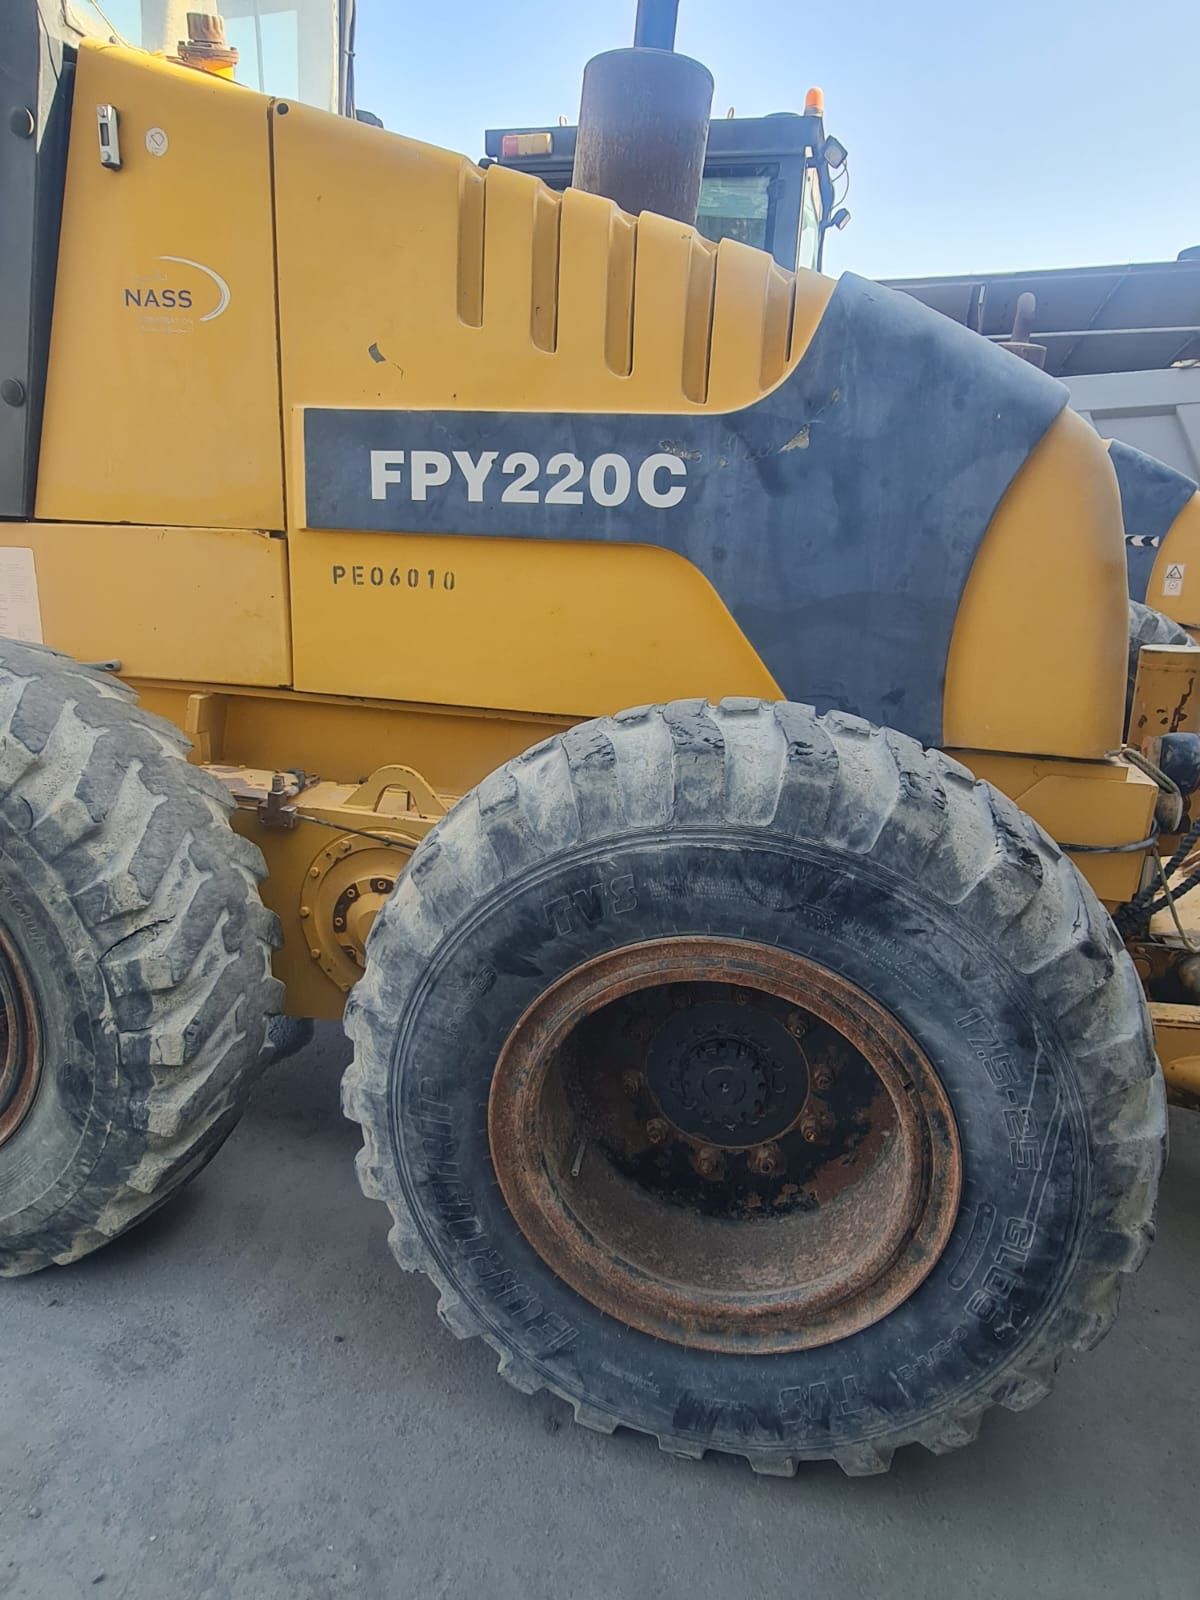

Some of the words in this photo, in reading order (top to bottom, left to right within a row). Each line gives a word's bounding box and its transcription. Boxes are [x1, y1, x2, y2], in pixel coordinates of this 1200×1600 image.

[124, 288, 192, 308] NASS
[370, 450, 687, 508] FPY220C
[332, 565, 456, 590] PE06010
[543, 873, 638, 937] TVS
[953, 1008, 1041, 1170] 17.5-25
